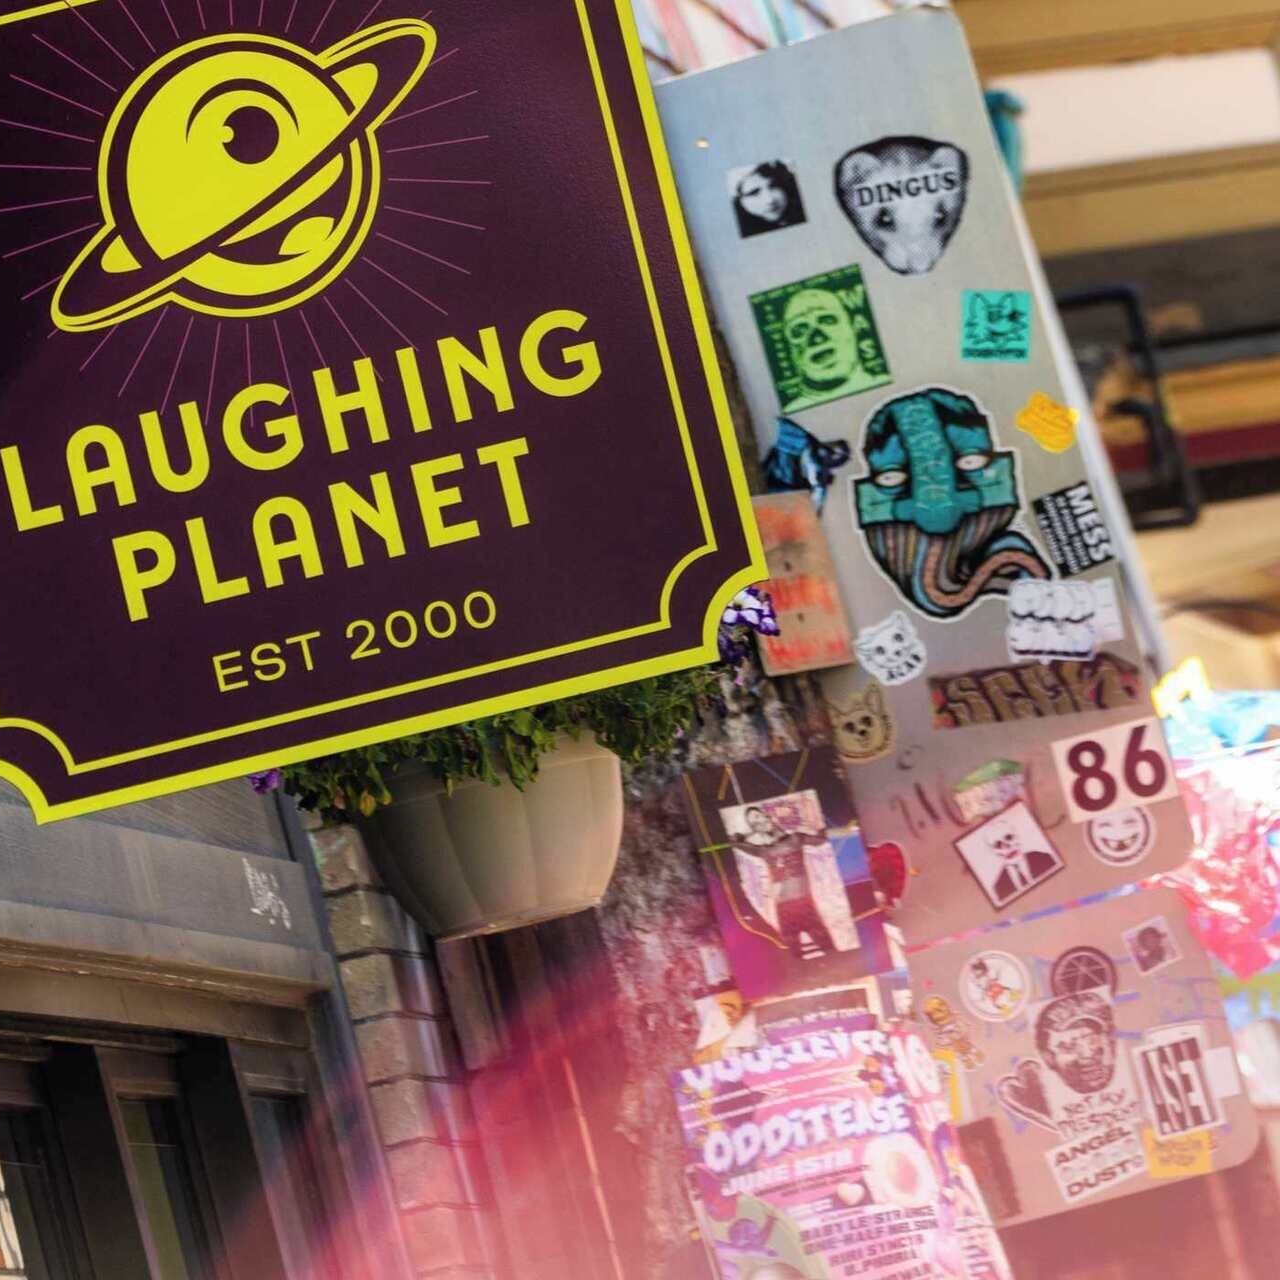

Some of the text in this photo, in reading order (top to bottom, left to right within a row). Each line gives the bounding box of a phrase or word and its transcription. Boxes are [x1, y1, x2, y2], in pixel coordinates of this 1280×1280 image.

[856, 171, 957, 207] DINGUS
[0, 309, 602, 532] LAUGHING
[111, 437, 530, 622] PLANET
[1066, 485, 1111, 561] MESS
[212, 590, 497, 693] EST 2000
[1067, 725, 1167, 813] 86
[1055, 1126, 1132, 1167] ANGEL
[1067, 1161, 1132, 1198] DUST
